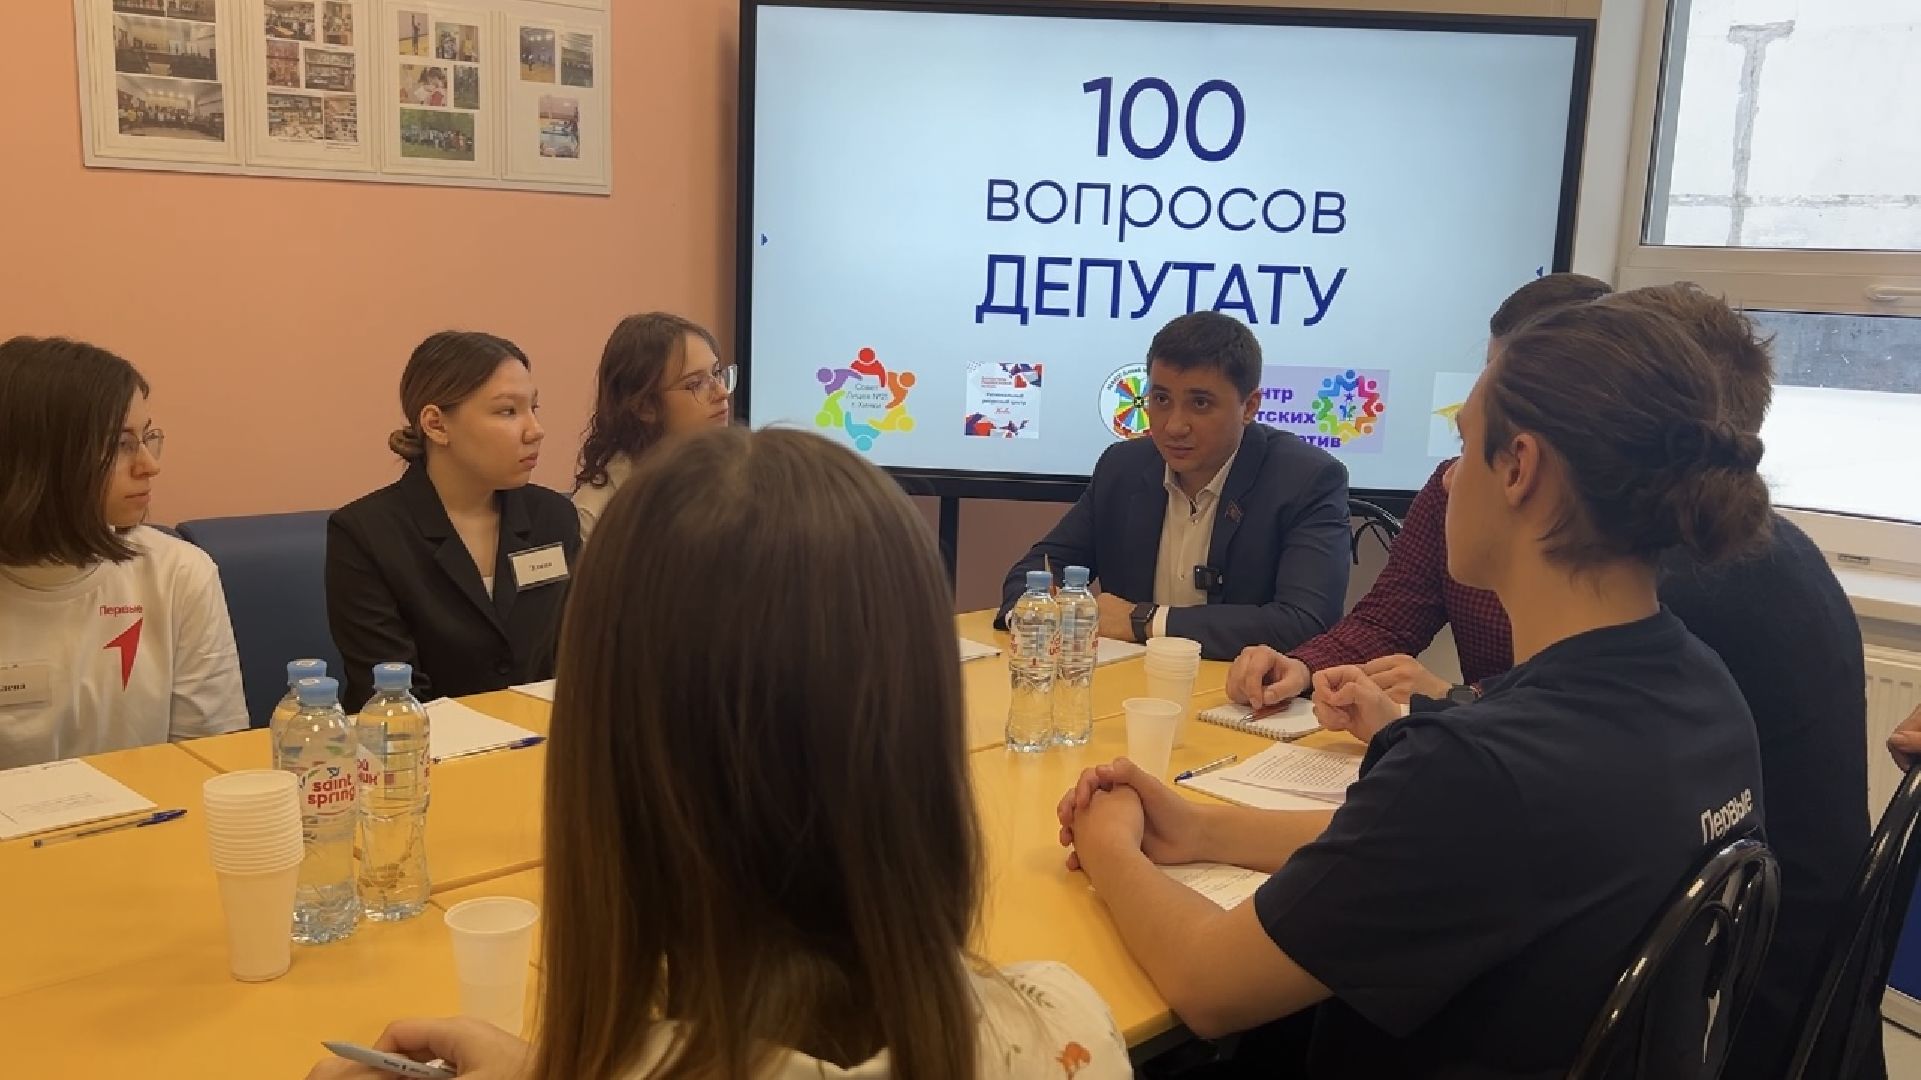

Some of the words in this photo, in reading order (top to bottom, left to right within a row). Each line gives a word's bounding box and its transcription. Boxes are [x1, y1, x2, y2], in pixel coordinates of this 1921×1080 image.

[1083, 77, 1246, 162] 100
[987, 179, 1347, 242] вопросов
[975, 254, 1348, 326] ДЕПУТАТУ
[1260, 388, 1293, 403] нтр
[1257, 411, 1316, 423] тских
[99, 604, 143, 617] Первые
[312, 773, 352, 793] saint
[307, 785, 355, 809] spring
[1701, 788, 1752, 846] Первые
